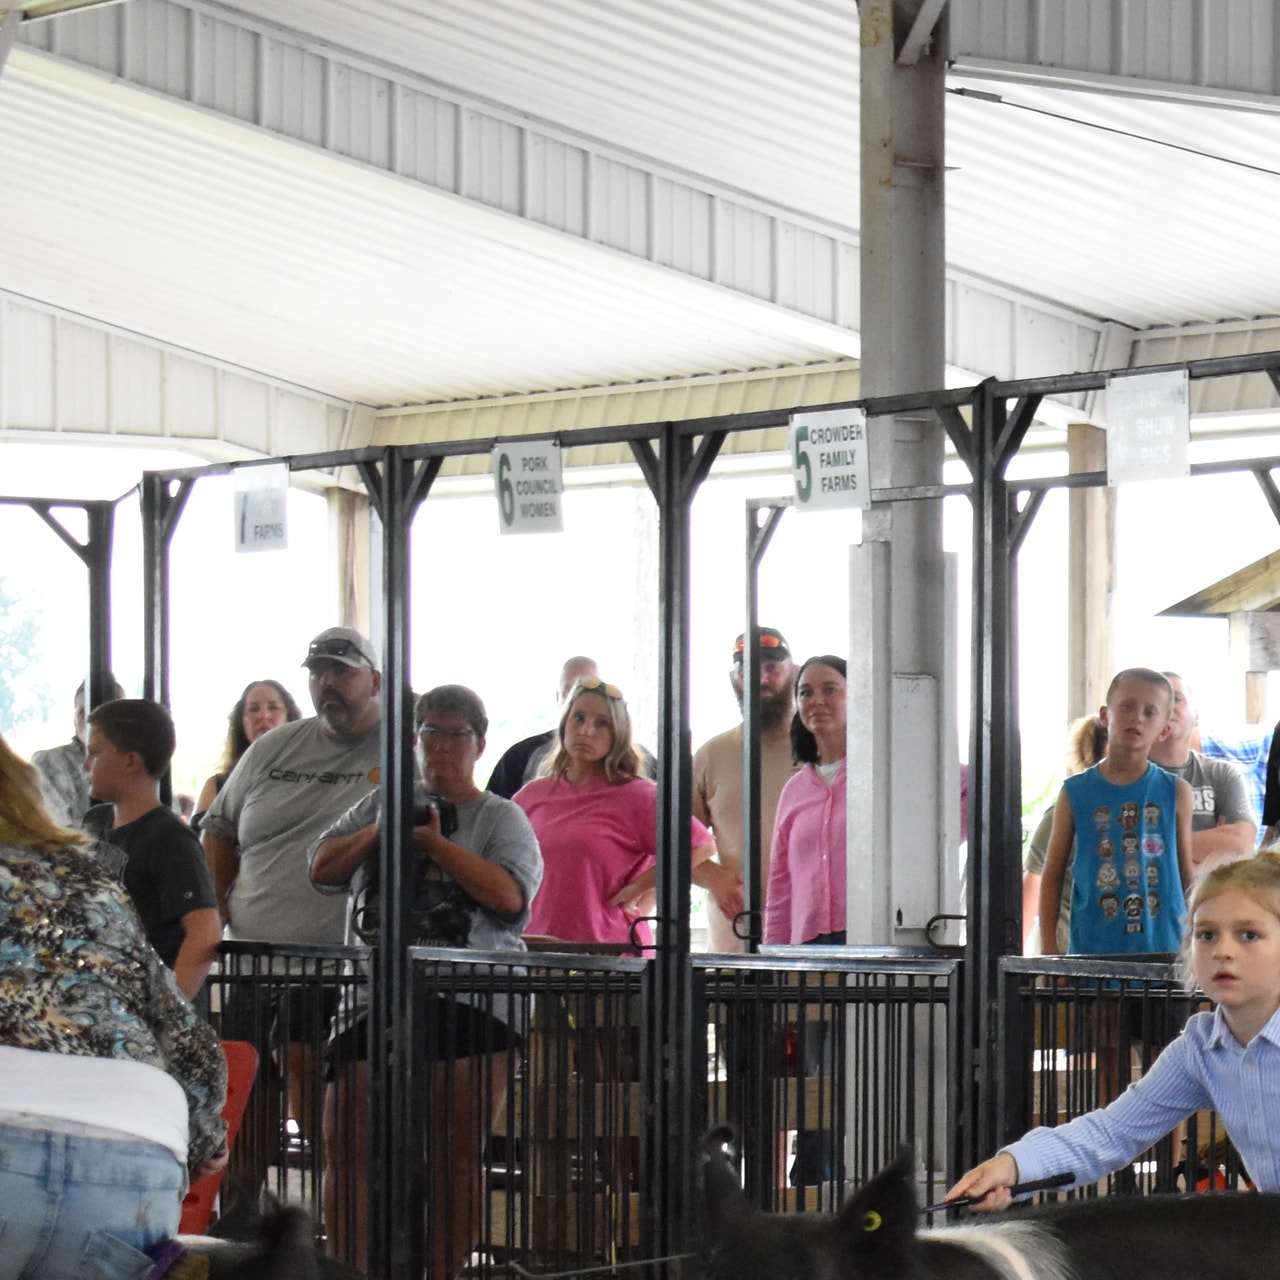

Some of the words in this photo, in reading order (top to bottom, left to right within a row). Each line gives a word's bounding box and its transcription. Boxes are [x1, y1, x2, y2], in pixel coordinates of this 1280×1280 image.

[810, 424, 863, 445] CROWDER
[1137, 416, 1175, 437] SHOW
[522, 456, 548, 472] PORK
[795, 425, 812, 503] 5
[820, 449, 856, 469] FAMILY
[499, 453, 514, 527] 6
[516, 479, 558, 495] COUNCIL
[821, 474, 857, 493] FARMS
[520, 502, 557, 518] WOMEN
[254, 522, 284, 541] FARMS
